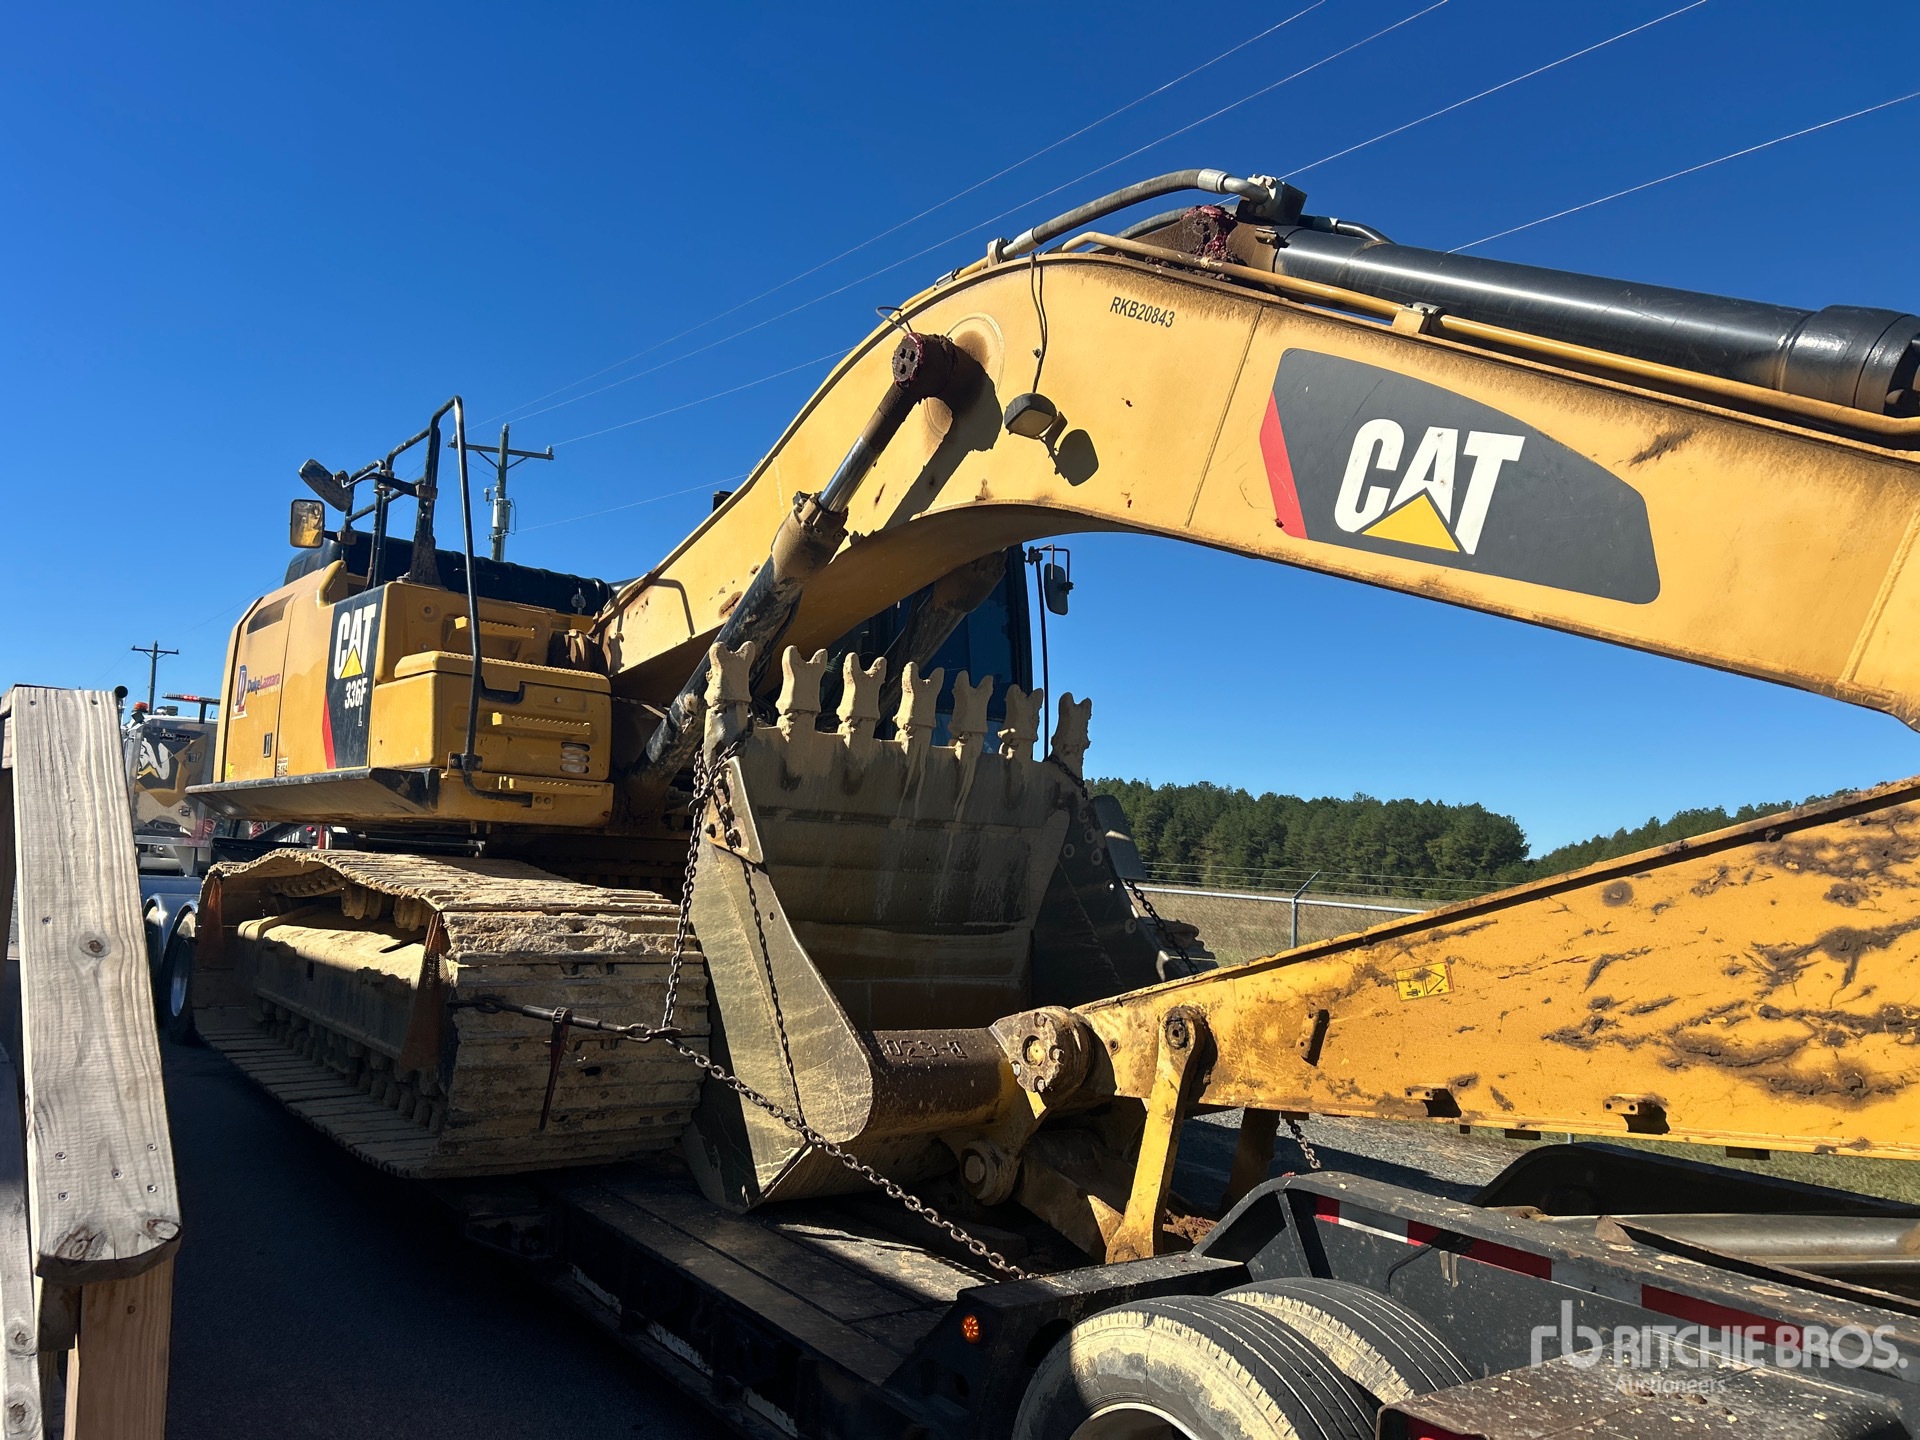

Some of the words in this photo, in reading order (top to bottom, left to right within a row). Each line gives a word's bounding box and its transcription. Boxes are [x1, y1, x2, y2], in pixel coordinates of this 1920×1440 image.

[1110, 296, 1175, 328] RKB20843
[1334, 418, 1526, 556] CAT
[333, 603, 377, 680] CAT
[344, 677, 368, 709] 336F
